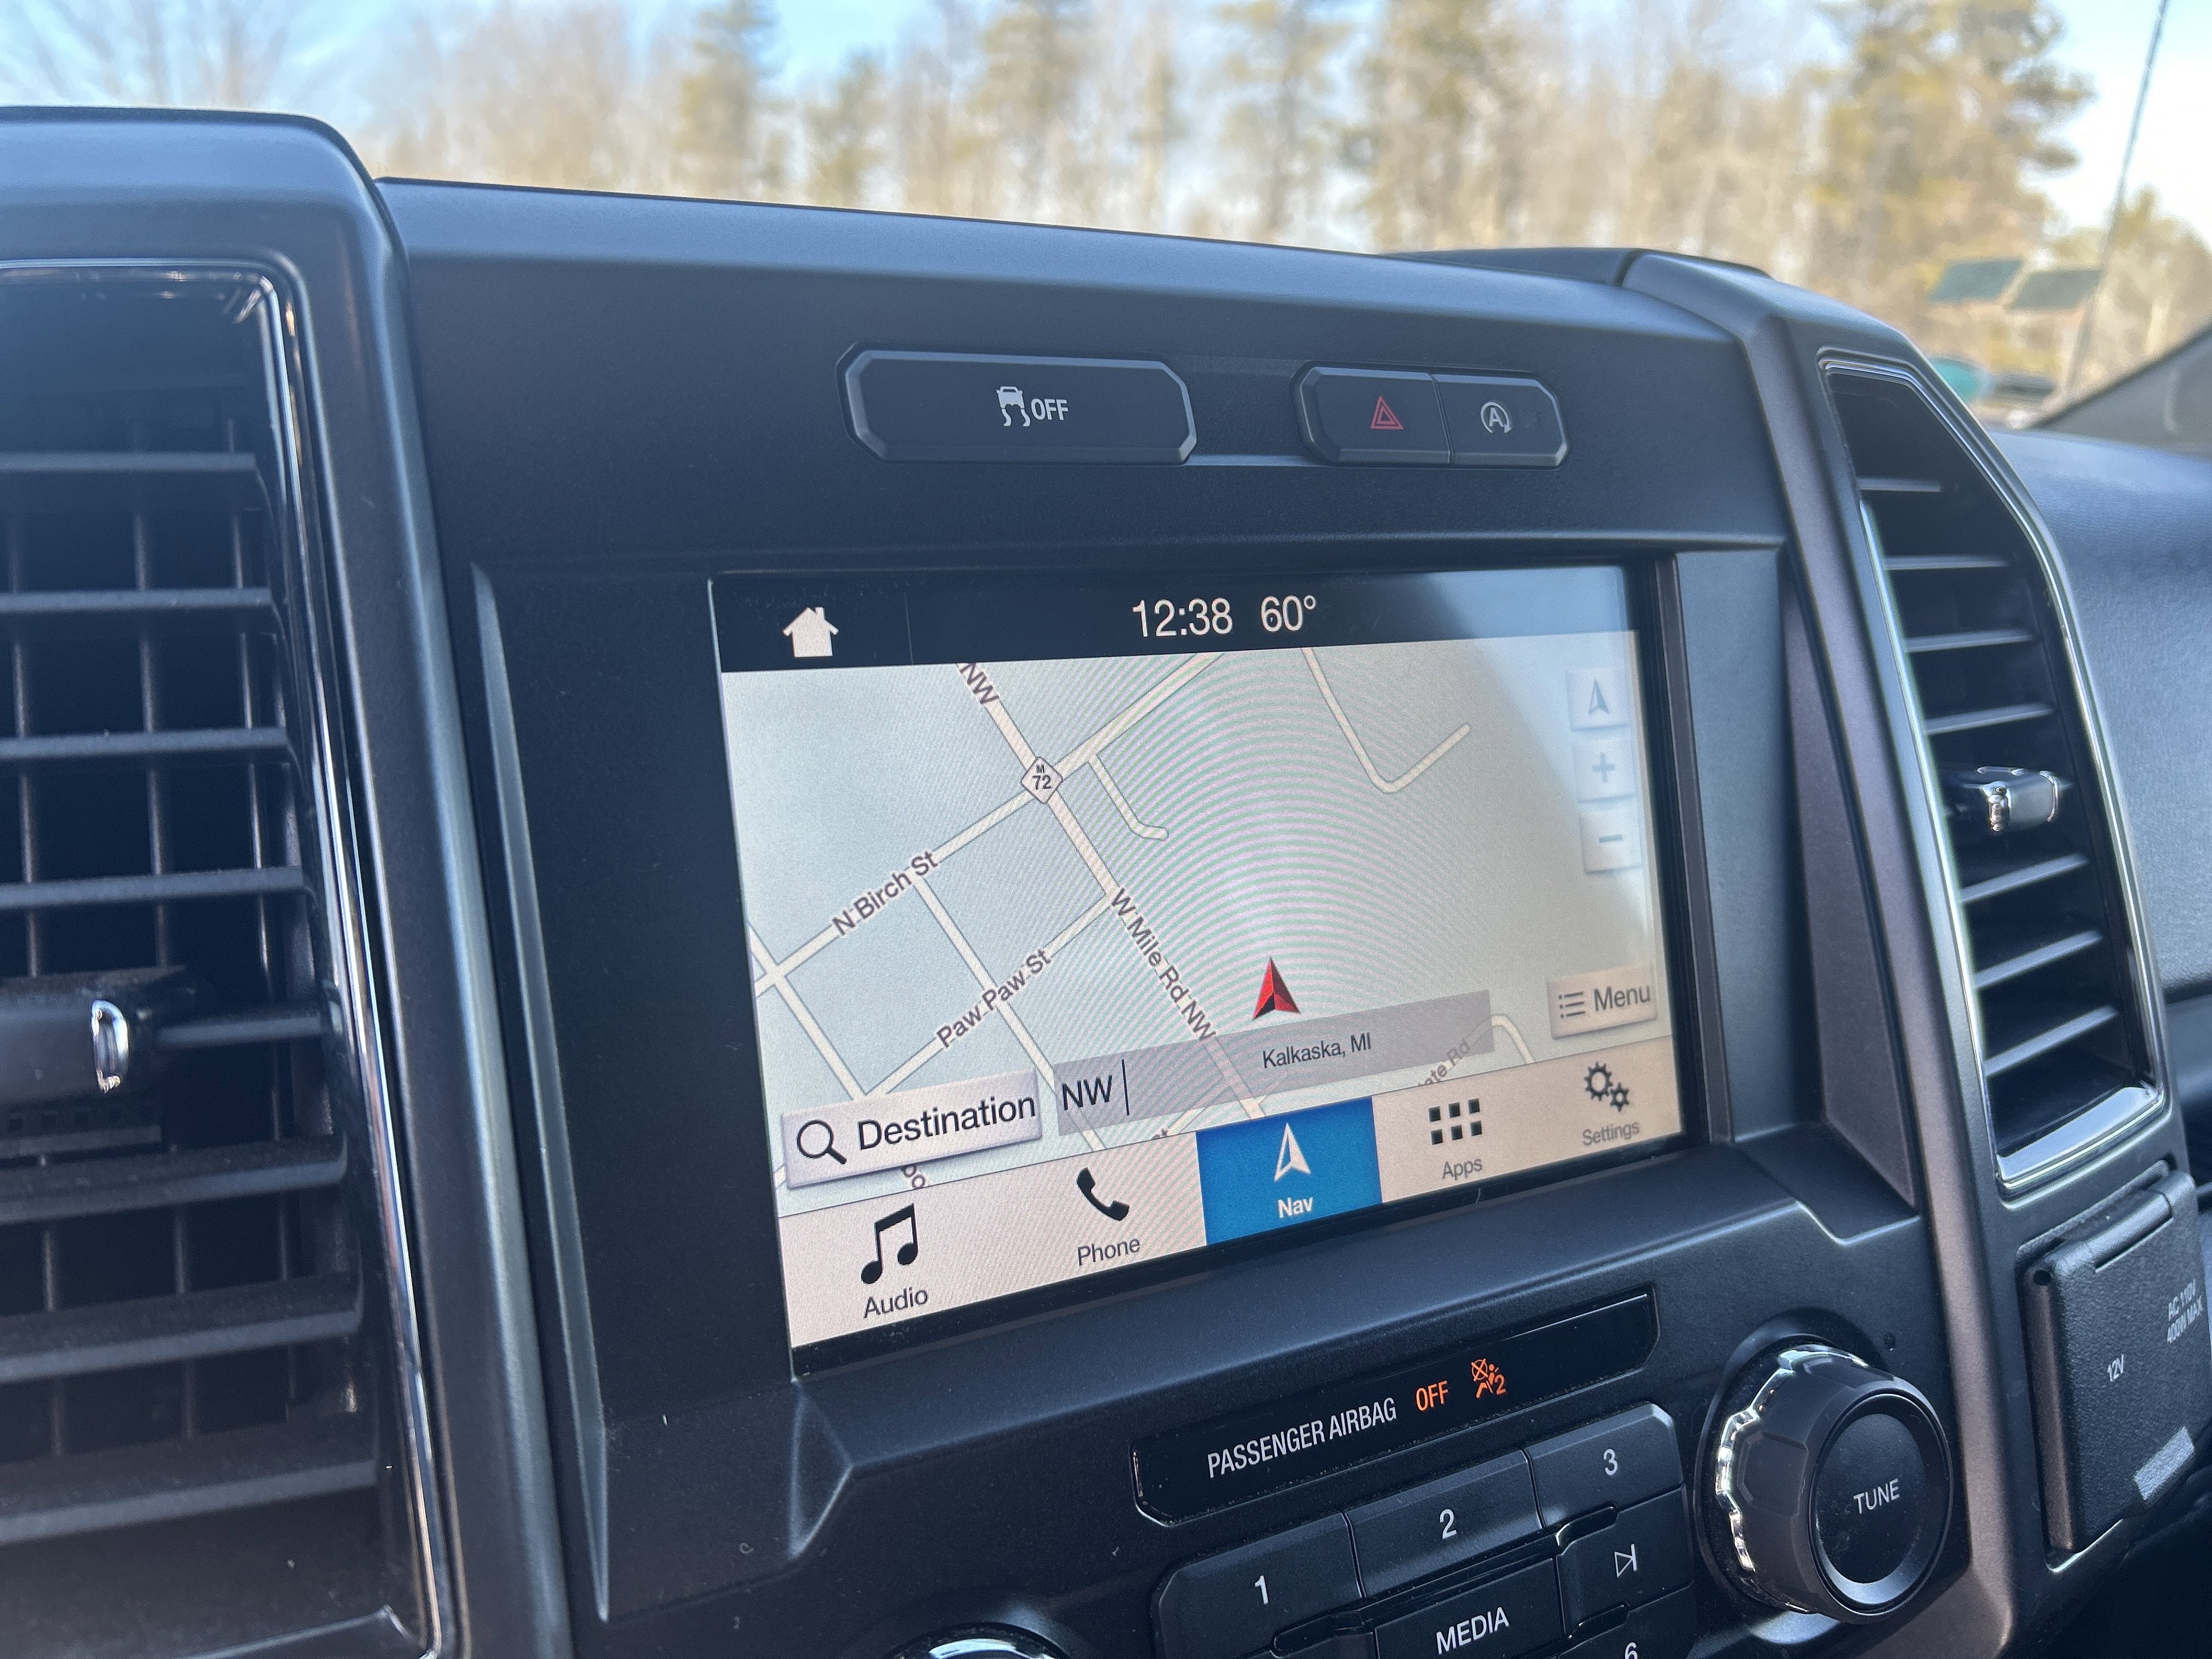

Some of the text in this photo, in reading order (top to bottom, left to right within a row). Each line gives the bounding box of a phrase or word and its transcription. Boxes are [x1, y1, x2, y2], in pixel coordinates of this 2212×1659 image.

[1030, 398, 1069, 421] OFF
[1133, 595, 1317, 637] 12:38 60°
[959, 662, 1000, 704] NW
[1032, 775, 1052, 790] 72
[832, 851, 938, 935] N Birch St
[1111, 888, 1216, 1041] W Mile Rd NW
[937, 949, 1052, 1047] Paw Paw St
[1593, 985, 1651, 1013] Menu
[1262, 1032, 1372, 1069] Kalkaska, MI
[1062, 1075, 1114, 1110] NW
[857, 1096, 1036, 1150] Destination
[1582, 1119, 1640, 1146] Settings
[1442, 1156, 1482, 1180] Apps
[1278, 1196, 1313, 1218] Nav
[1077, 1236, 1141, 1266] Phone
[862, 1286, 928, 1318] Audio
[2107, 1354, 2124, 1383] 12V
[1207, 1420, 1325, 1479] PASSENGER
[1328, 1397, 1397, 1440] AIRBAG
[1415, 1380, 1449, 1412] OFF
[1602, 1448, 1618, 1476] 3
[1853, 1479, 1900, 1515] TUNE
[1438, 1509, 1457, 1538] 2
[1255, 1575, 1269, 1604] 1
[1436, 1606, 1510, 1655] MEDIA
